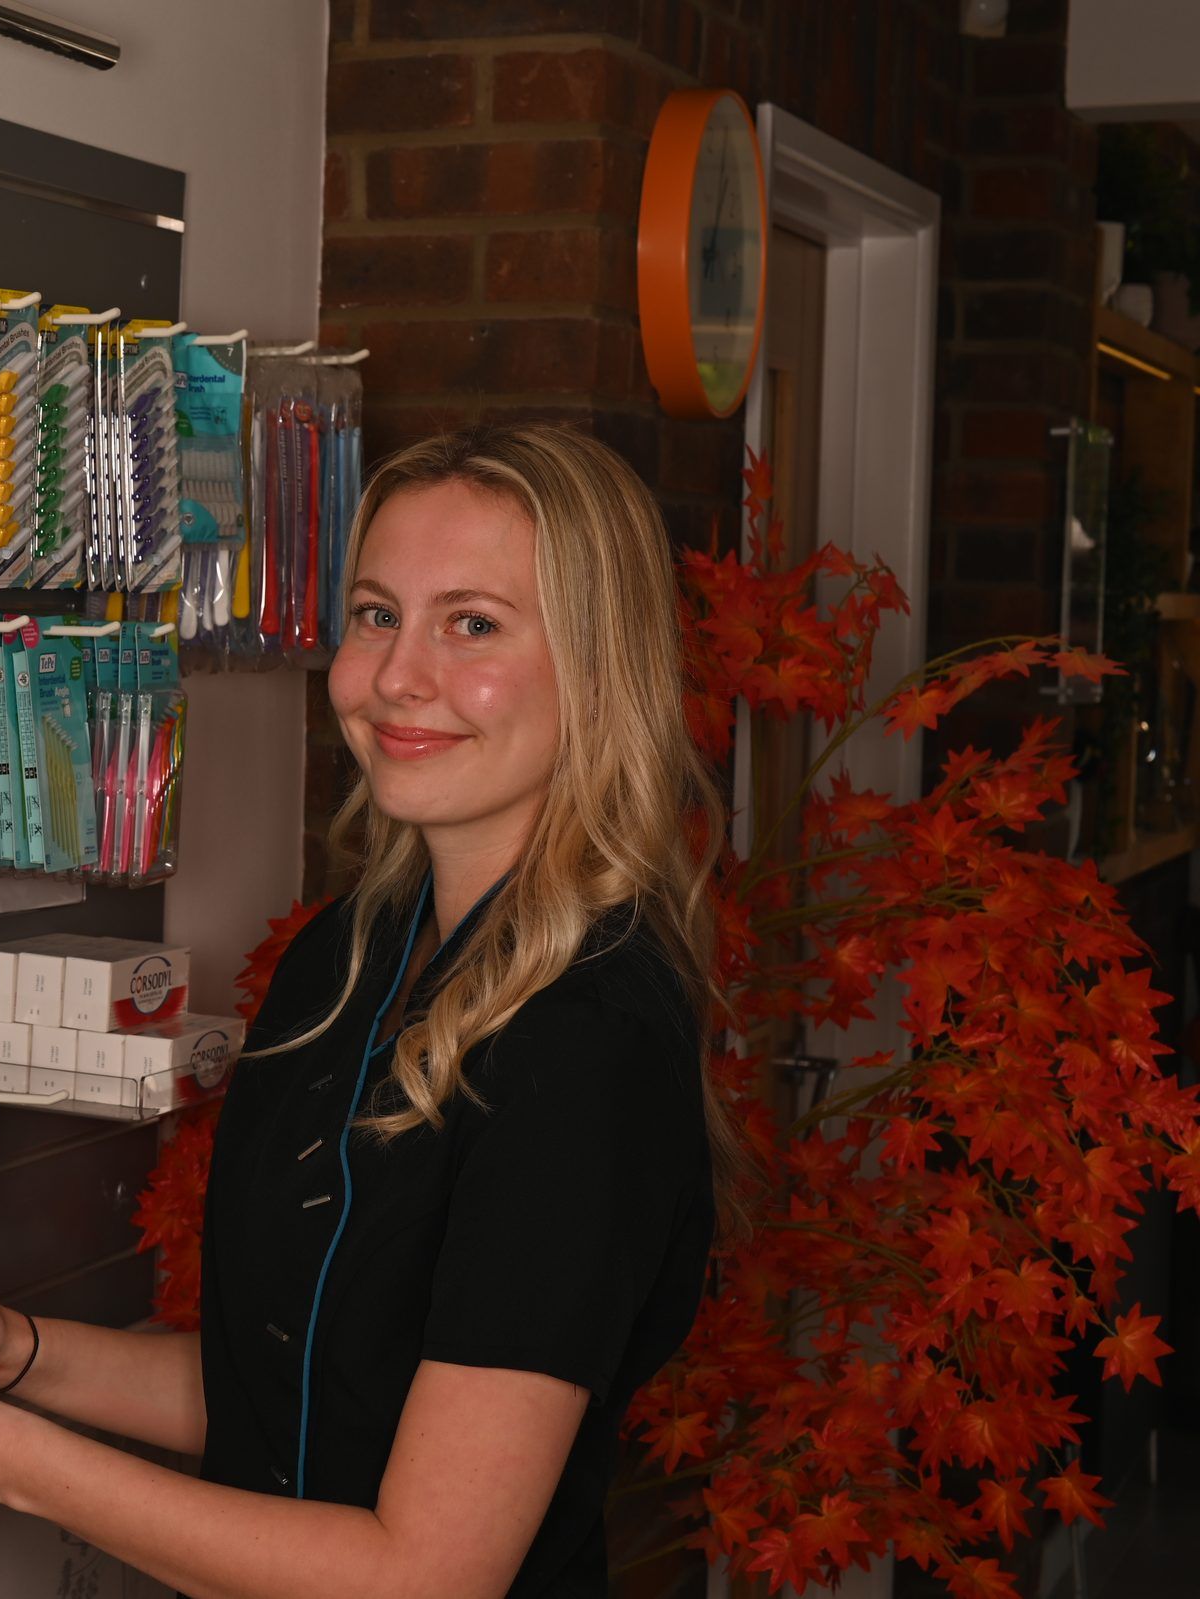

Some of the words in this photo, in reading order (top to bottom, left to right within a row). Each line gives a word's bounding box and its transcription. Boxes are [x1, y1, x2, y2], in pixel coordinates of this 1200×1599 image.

[227, 348, 234, 356] 7
[41, 657, 54, 670] TePe
[38, 674, 66, 684] Interdental
[40, 688, 54, 698] Brush
[130, 970, 172, 994] CORSODYL
[191, 1044, 229, 1070] CORSODYL
